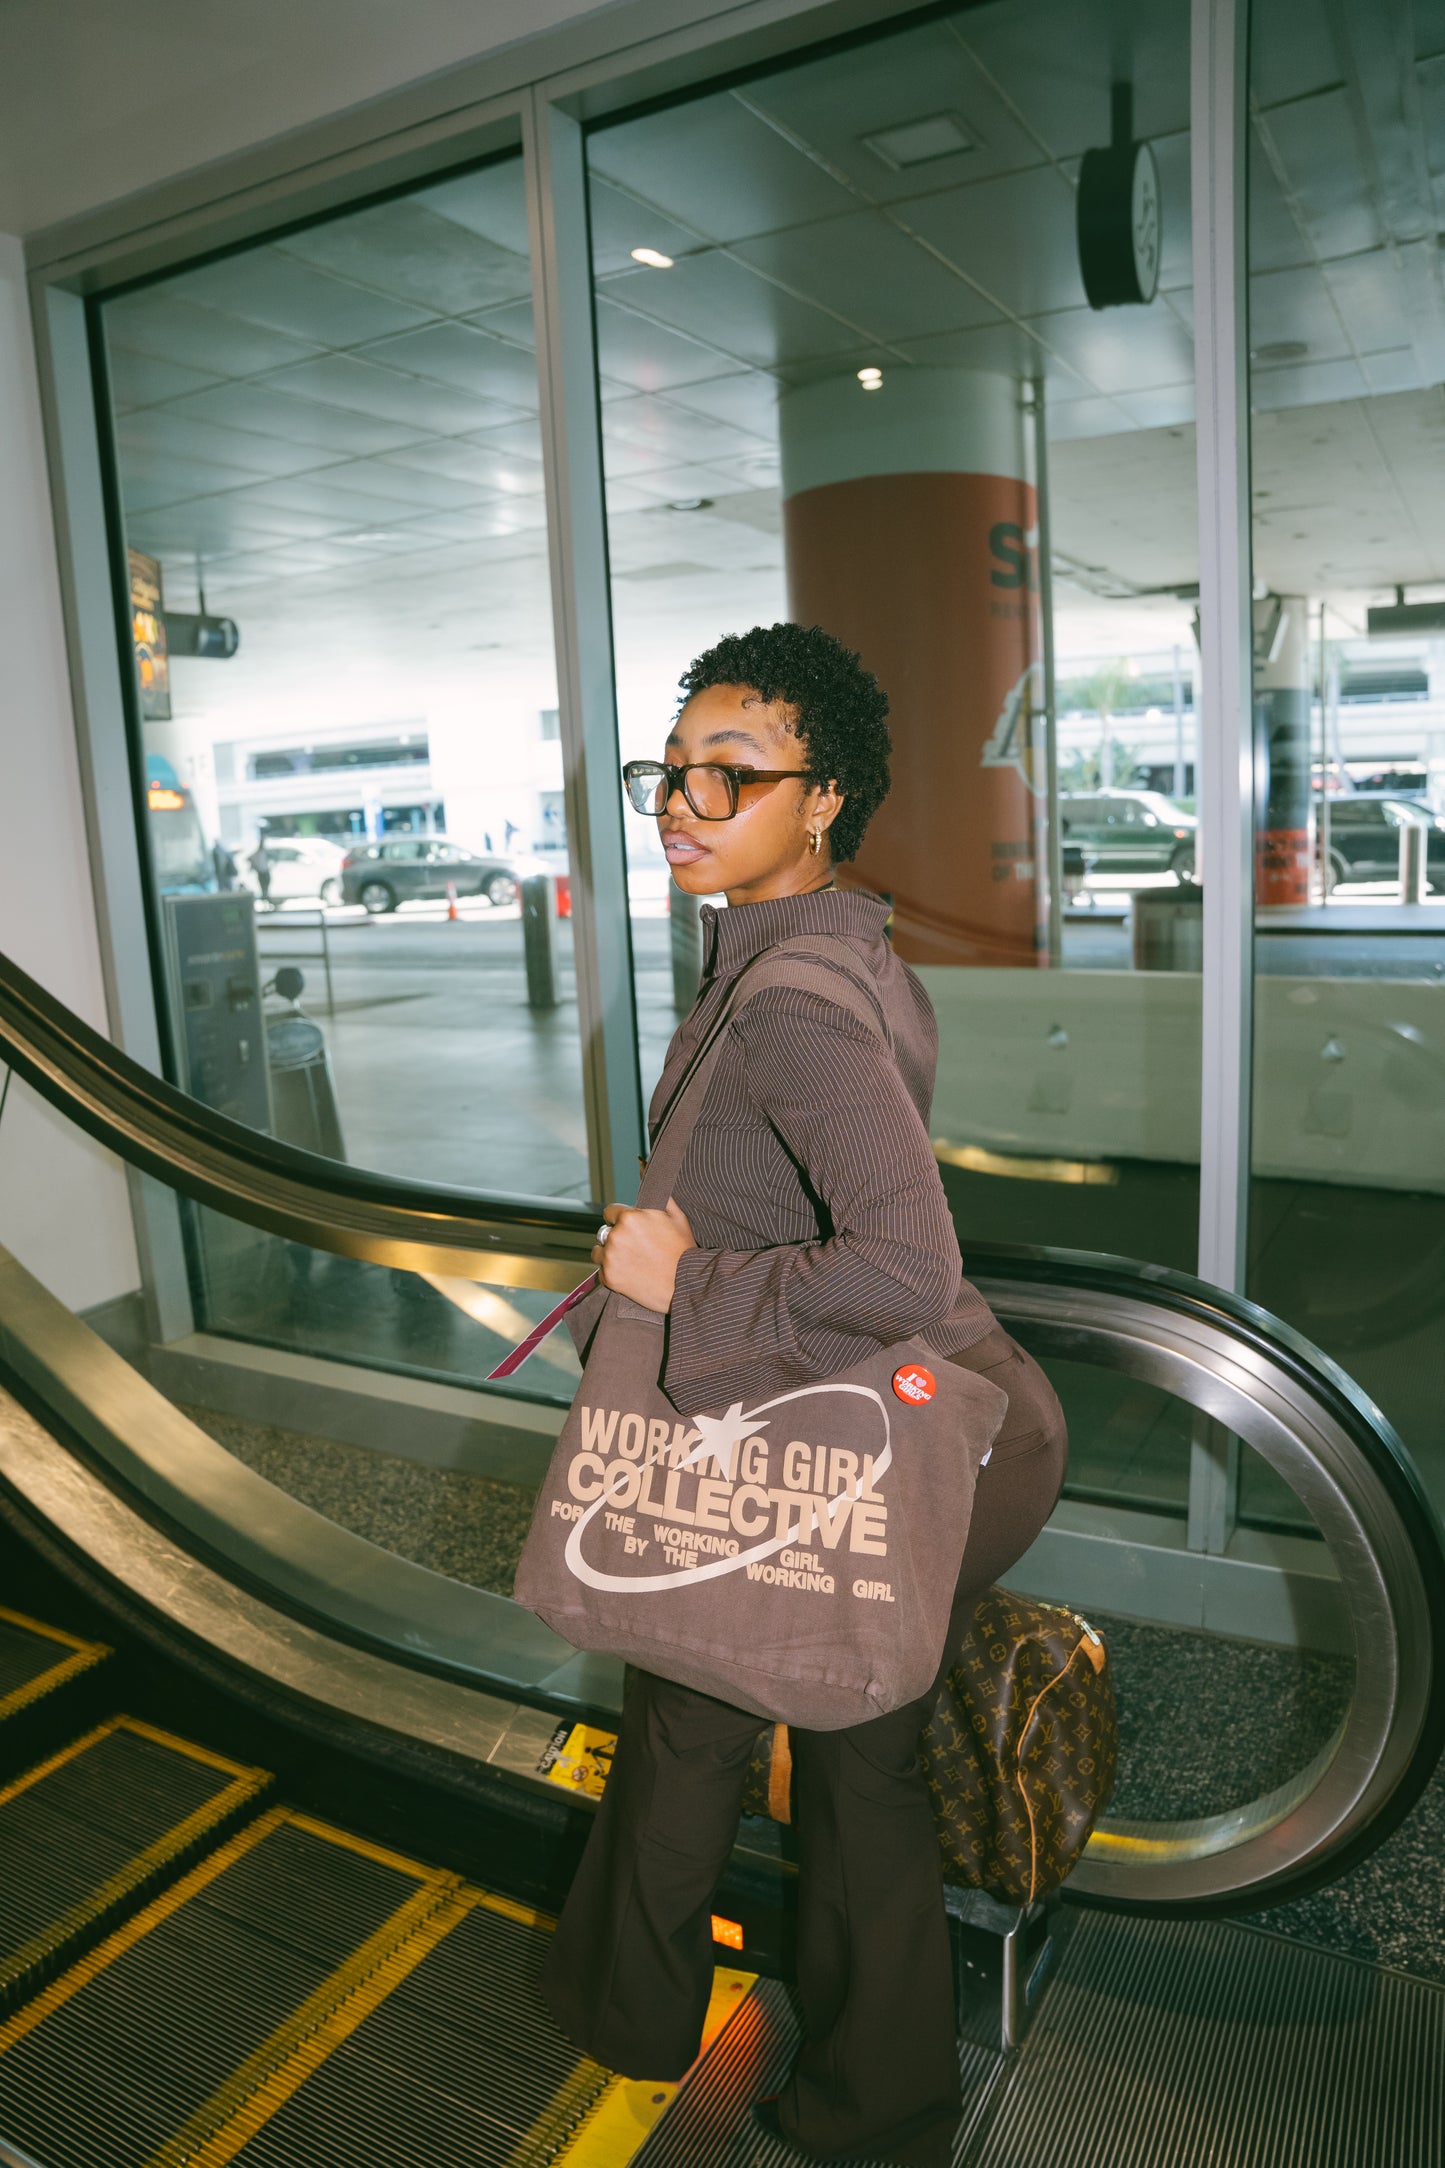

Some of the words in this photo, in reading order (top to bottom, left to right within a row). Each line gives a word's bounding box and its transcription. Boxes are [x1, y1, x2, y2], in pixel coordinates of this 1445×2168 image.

[895, 1374, 932, 1401] WORKING
[898, 1383, 921, 1401] GIRLS
[905, 1372, 918, 1383] I
[783, 1441, 885, 1503] GIRL
[567, 1452, 888, 1557] COLLECTIVE
[551, 1500, 586, 1522] FOR
[604, 1511, 636, 1535] THE
[653, 1524, 740, 1558] WORKING
[779, 1549, 825, 1573] GIRL
[623, 1536, 649, 1557] BY
[663, 1546, 699, 1569] THE
[746, 1562, 835, 1594] WORKING
[852, 1579, 896, 1603] GIRL
[541, 1730, 568, 1768] CAUTION
